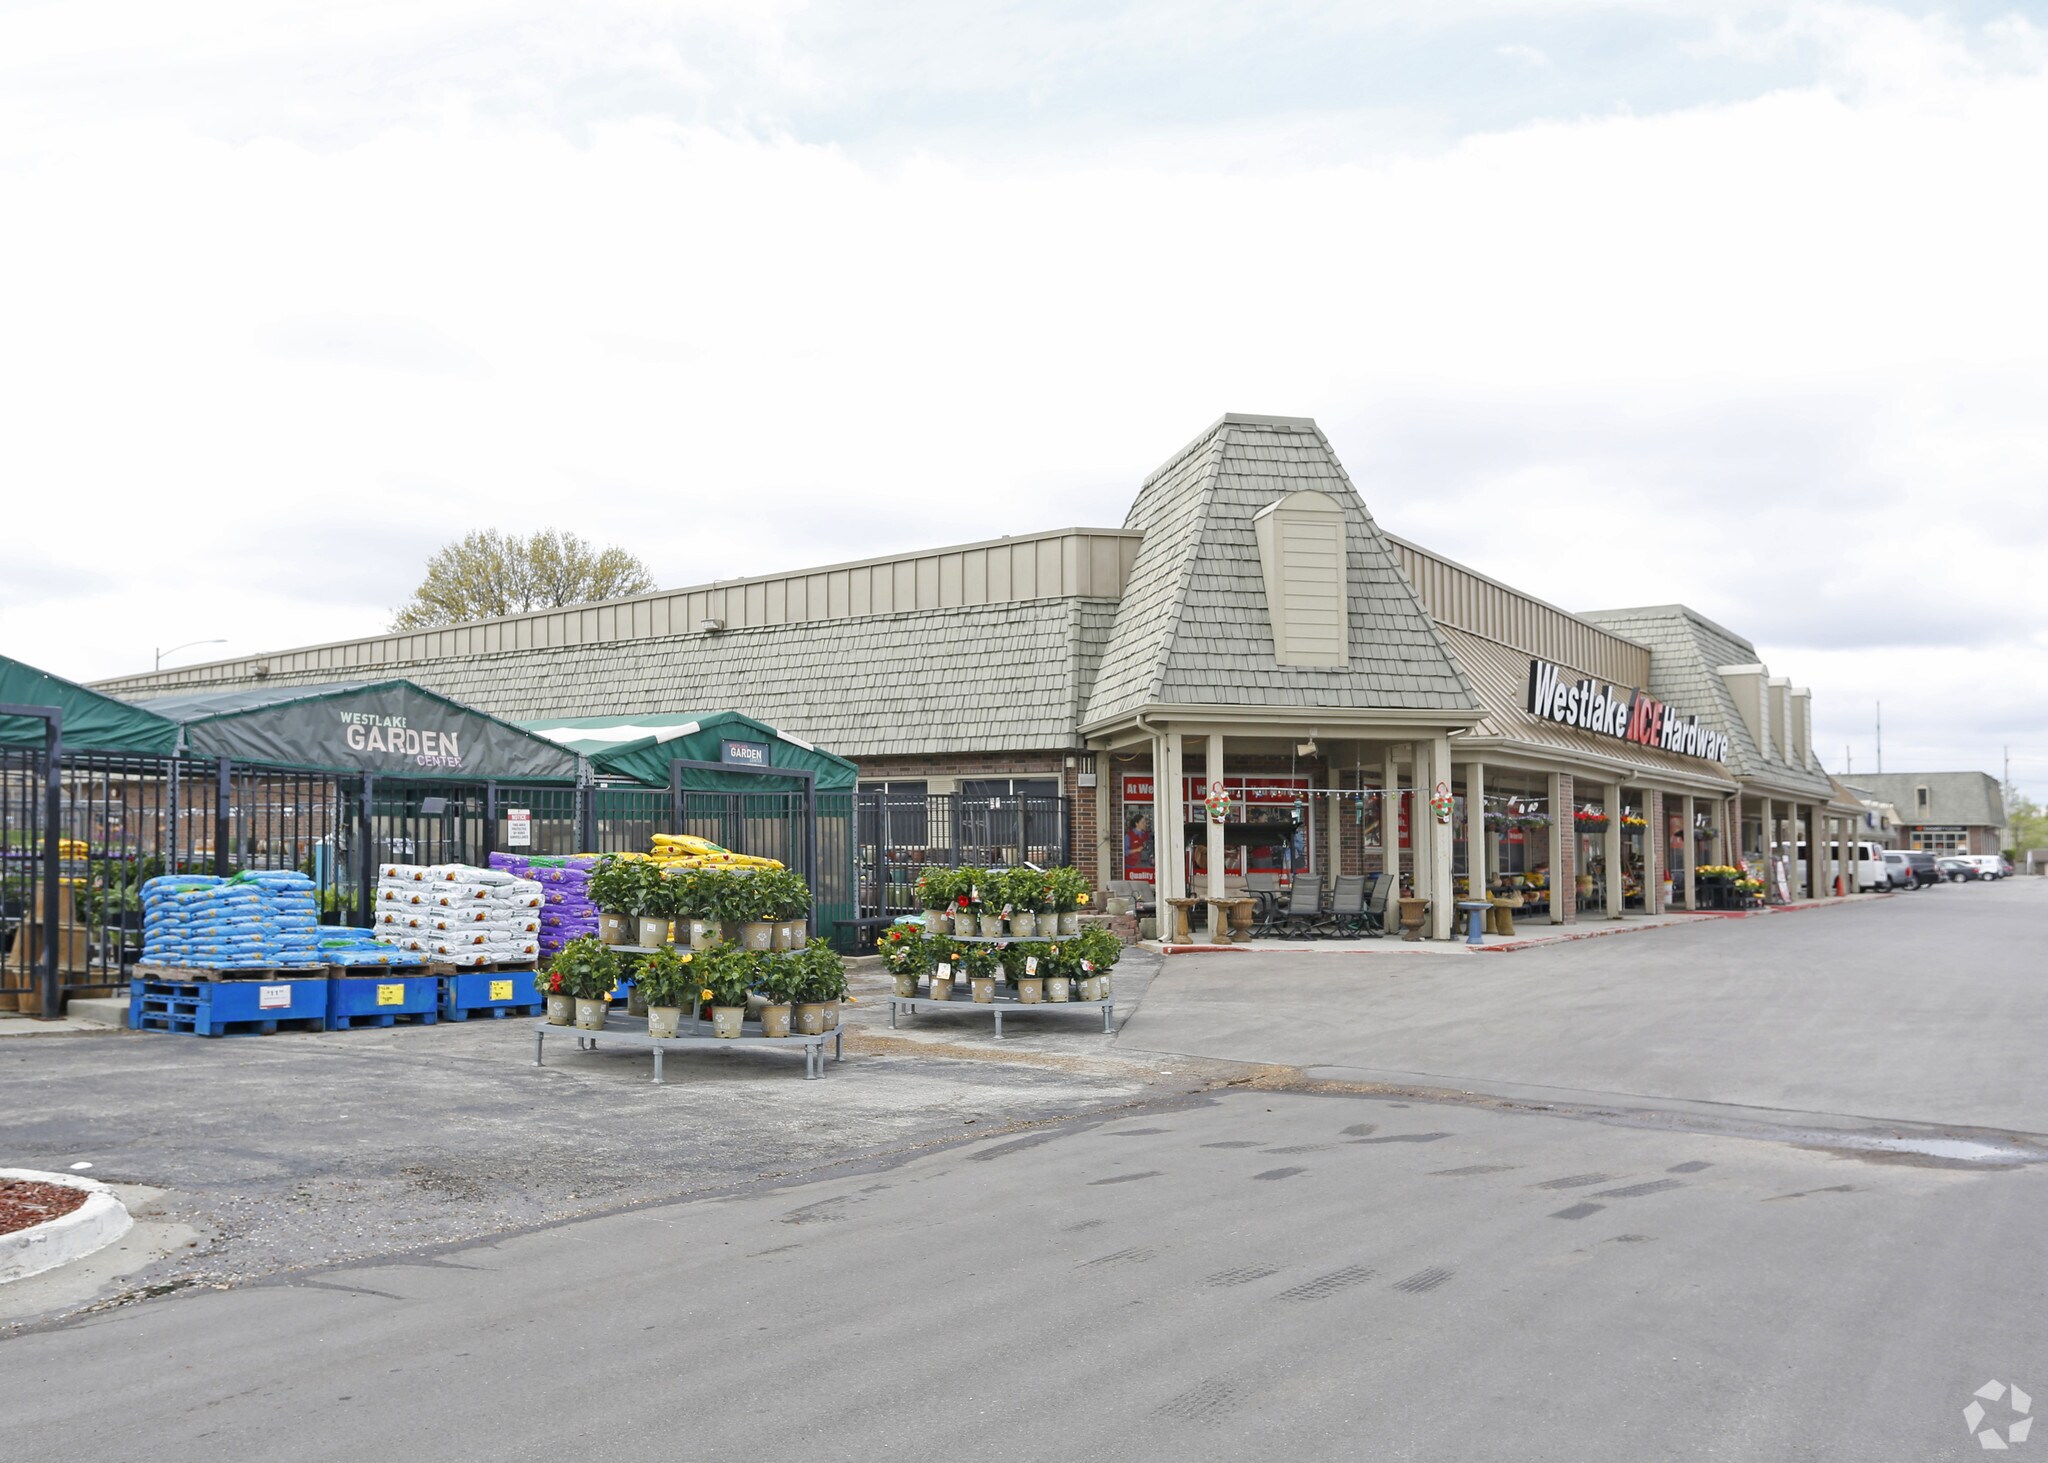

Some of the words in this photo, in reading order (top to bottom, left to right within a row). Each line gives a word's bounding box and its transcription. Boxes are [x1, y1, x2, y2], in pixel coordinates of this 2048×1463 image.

[1533, 660, 1628, 739] Westlake
[1626, 687, 1664, 747] ACE
[1661, 705, 1729, 764] Hardware
[340, 711, 407, 729] WESTLAKE
[346, 724, 459, 757] GARDEN
[730, 747, 762, 760] GARDEN
[416, 754, 463, 768] CENTER
[1127, 783, 1137, 794] At
[1129, 871, 1153, 880] Quality
